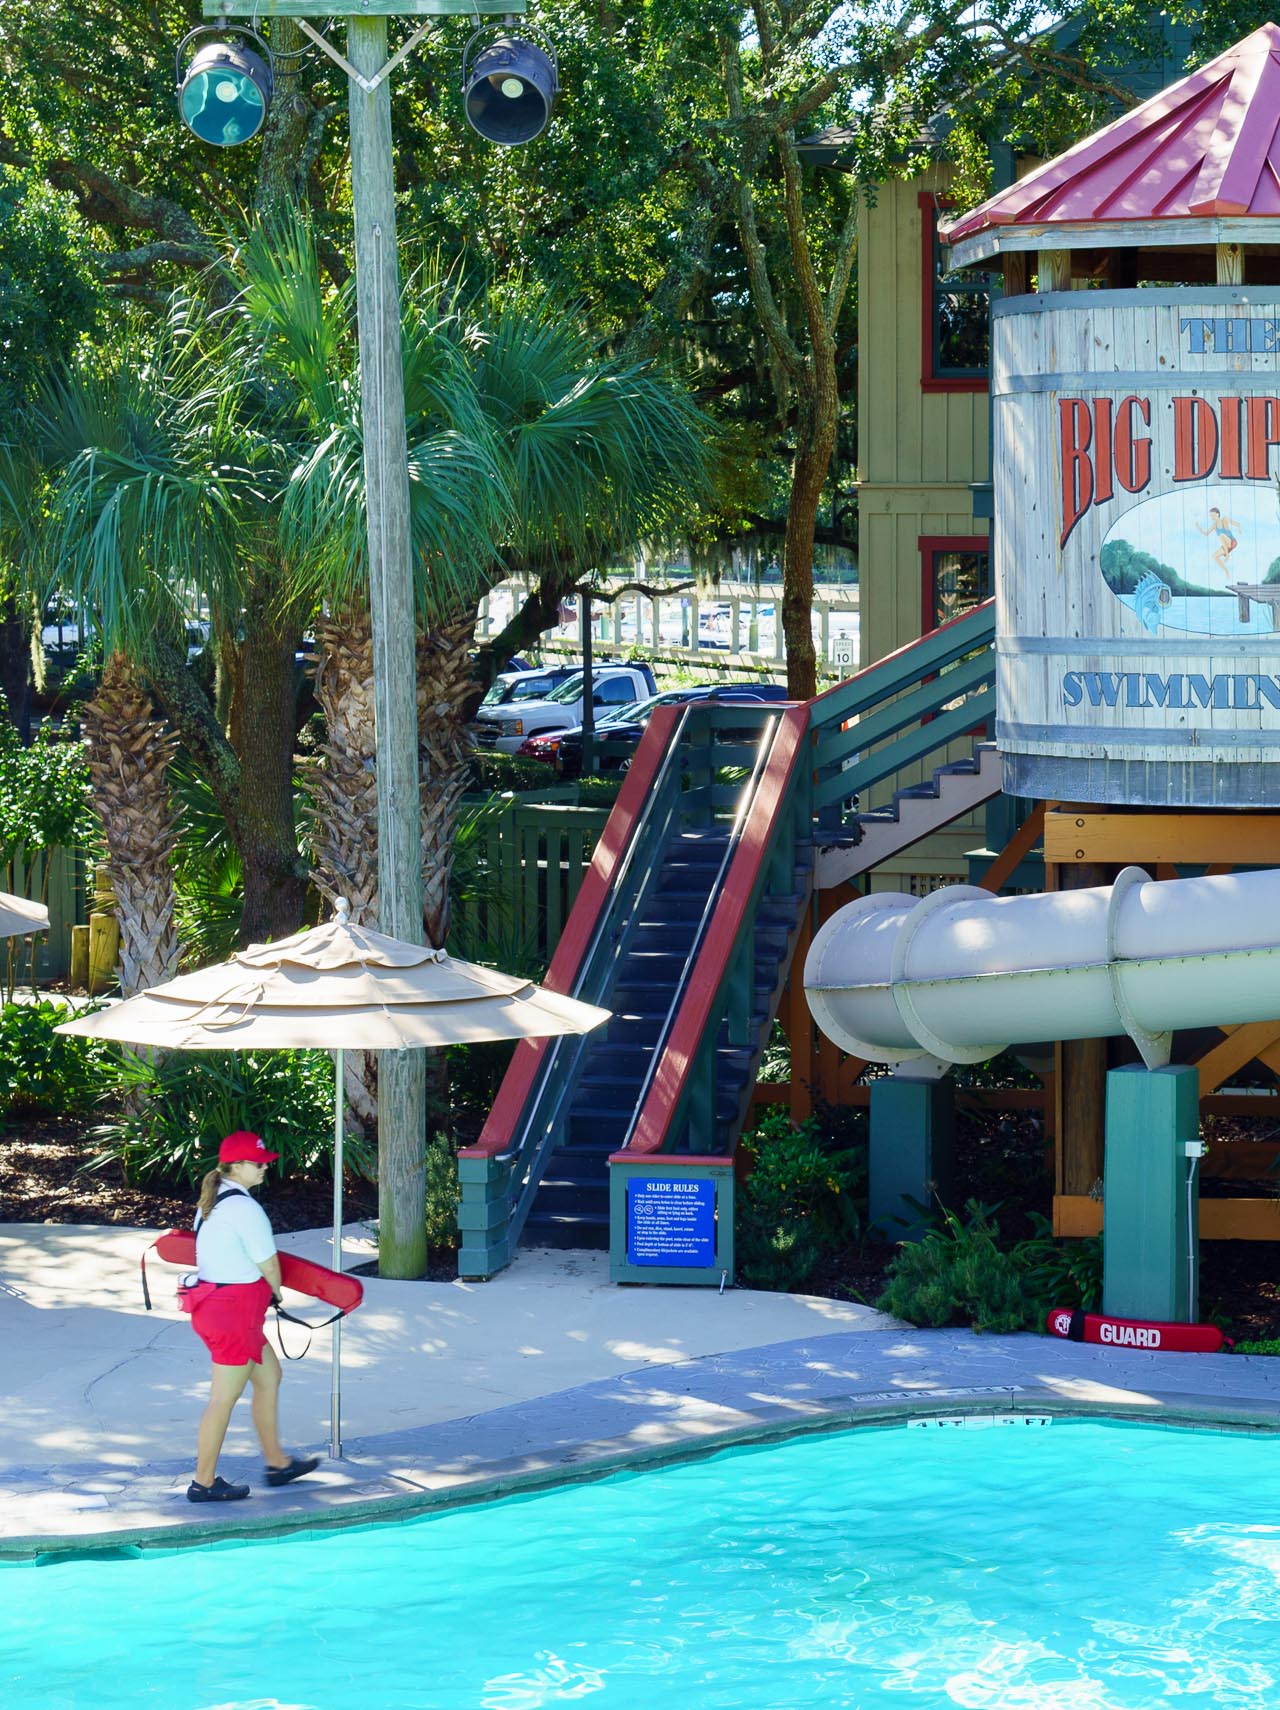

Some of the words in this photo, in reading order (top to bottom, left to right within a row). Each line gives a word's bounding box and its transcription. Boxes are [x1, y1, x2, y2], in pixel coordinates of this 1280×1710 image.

[1180, 317, 1280, 354] THE
[1058, 394, 1154, 551] BIG
[837, 653, 850, 663] 10
[646, 1182, 672, 1192] SLIDE
[673, 1183, 700, 1193] RULES
[1100, 1323, 1161, 1348] GUARD
[1025, 1418, 1049, 1426] FT
